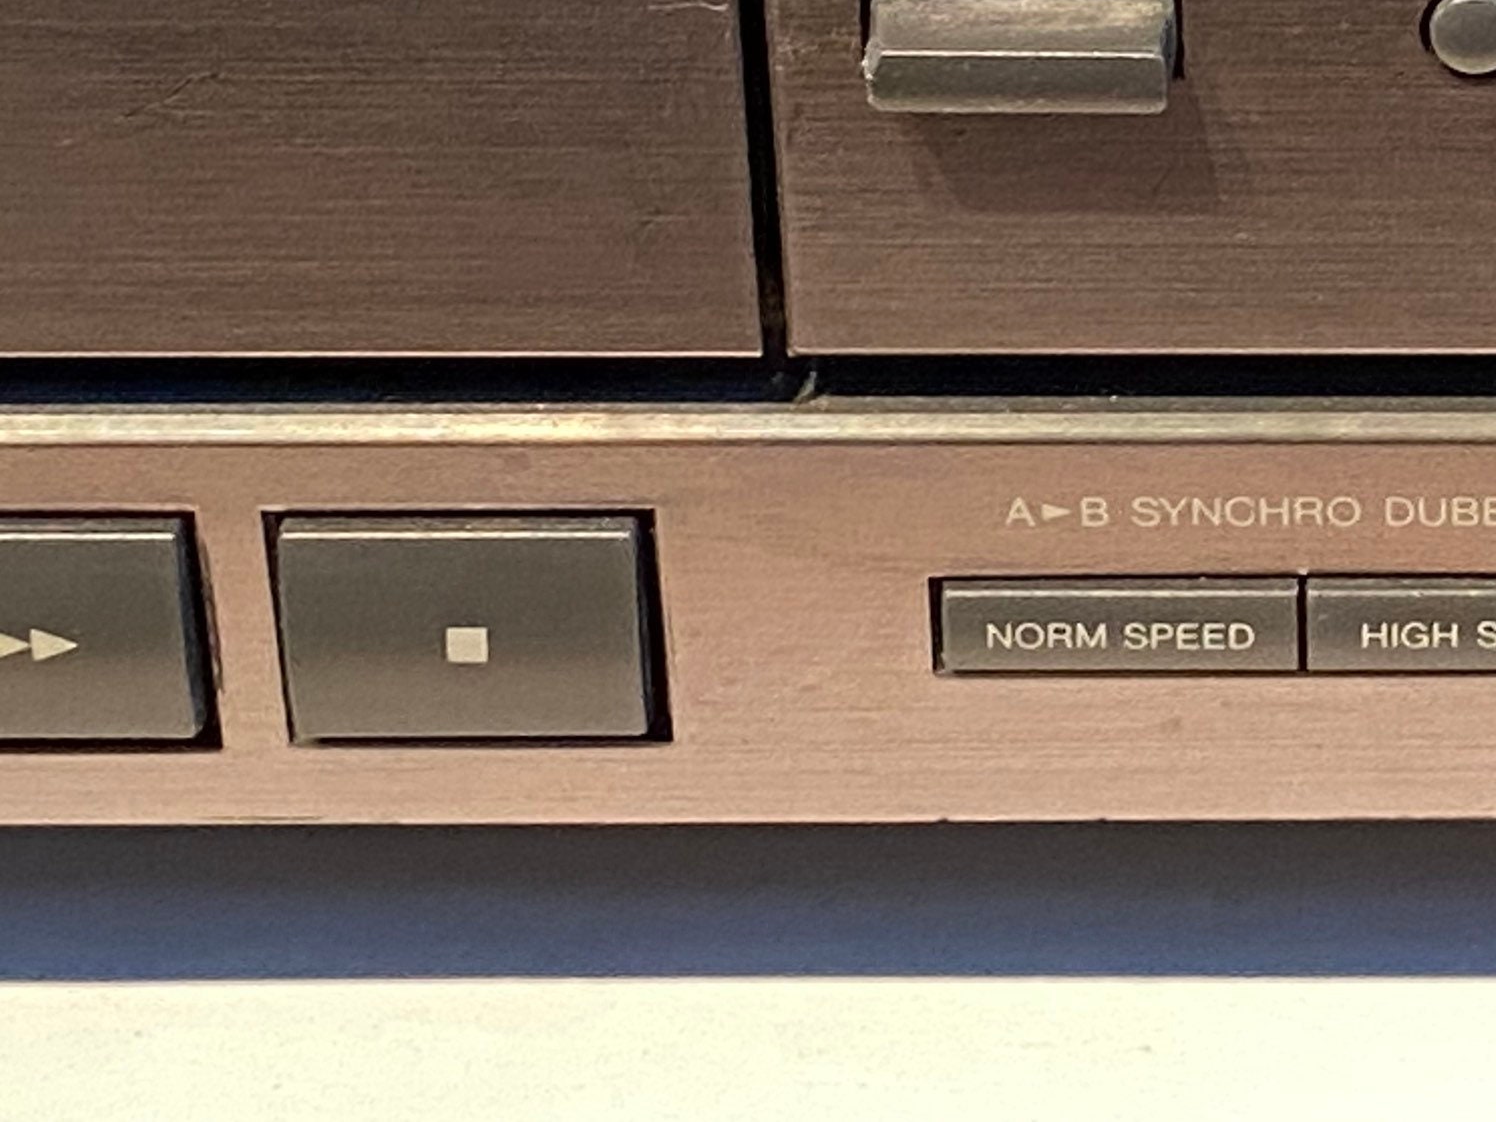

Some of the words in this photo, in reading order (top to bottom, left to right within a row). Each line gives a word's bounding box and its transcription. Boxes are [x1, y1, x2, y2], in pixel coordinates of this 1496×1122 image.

[1131, 496, 1362, 527] SYNCHRO
[987, 622, 1107, 650] NORM
[1124, 622, 1255, 650] SPEED
[1362, 622, 1458, 649] HIGH
